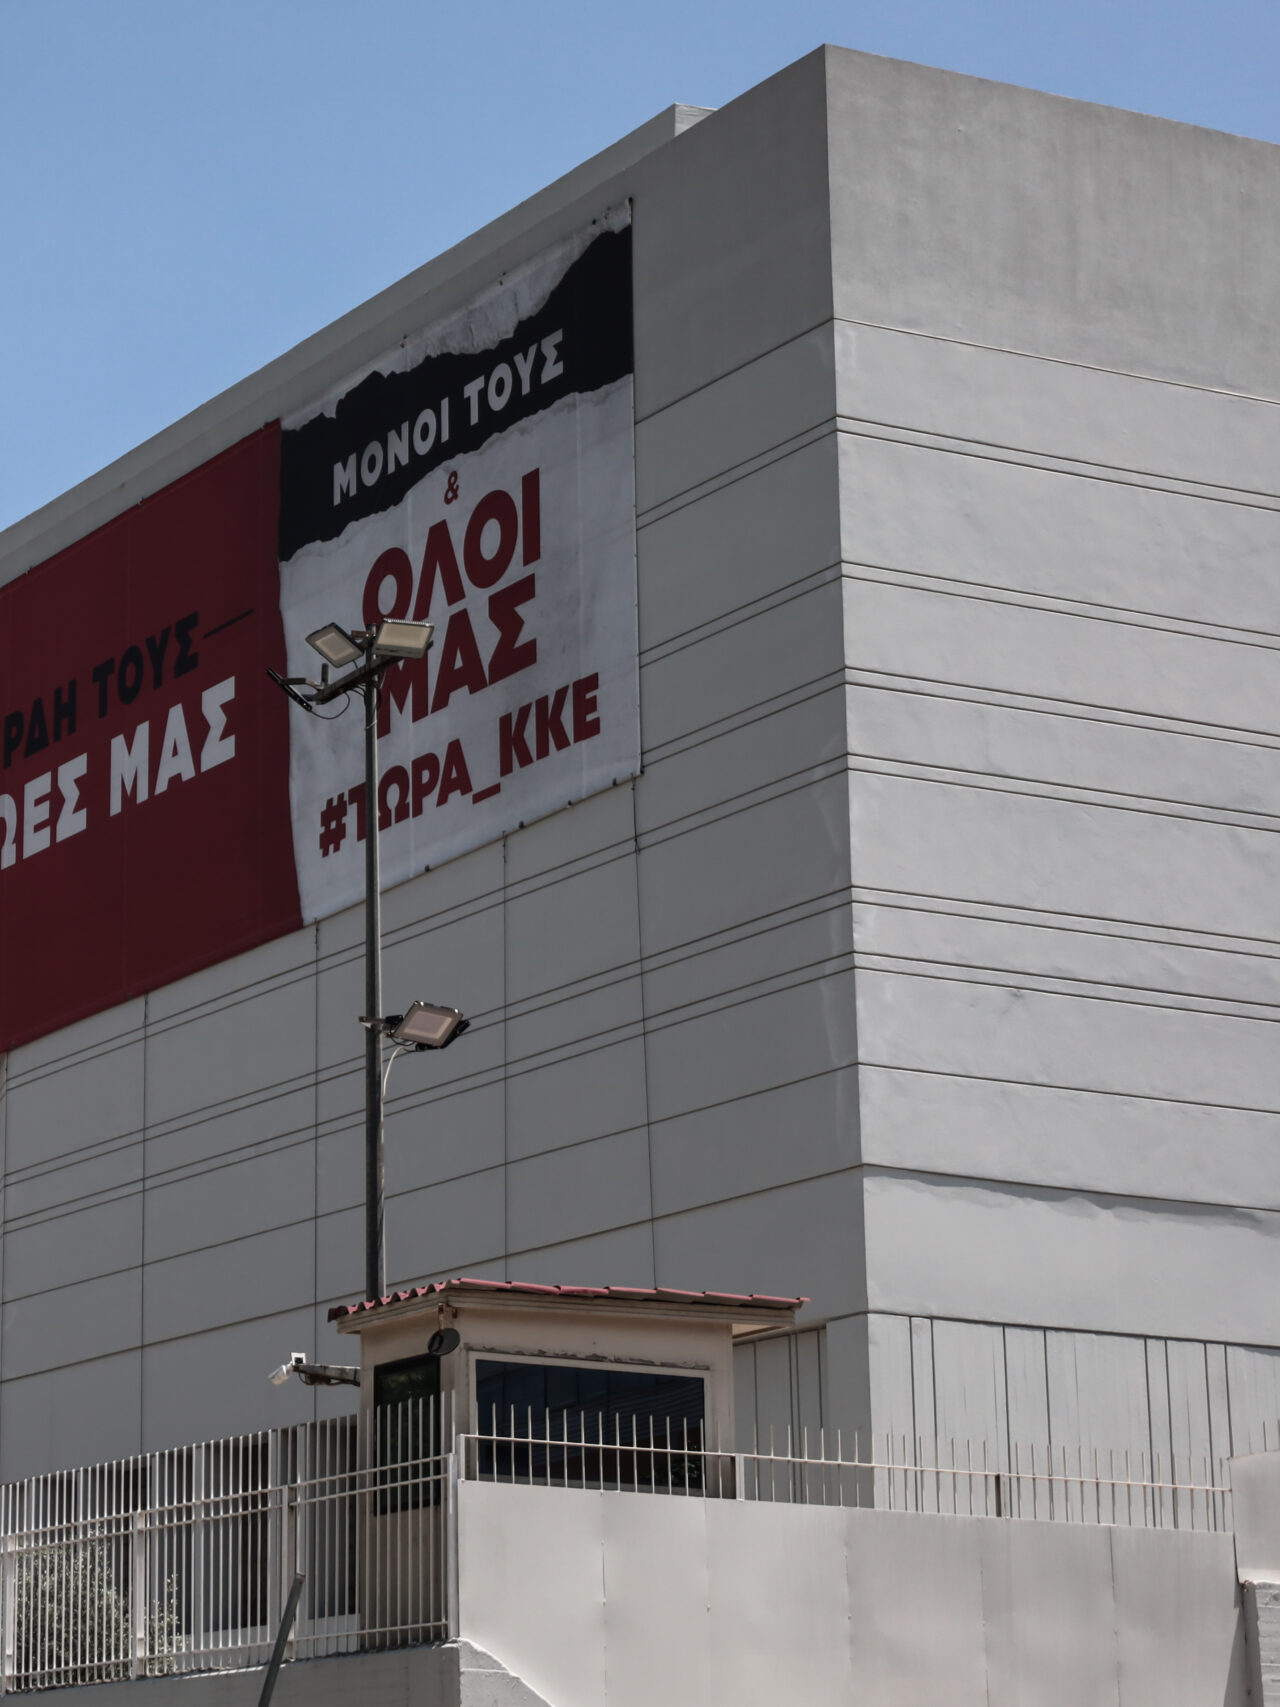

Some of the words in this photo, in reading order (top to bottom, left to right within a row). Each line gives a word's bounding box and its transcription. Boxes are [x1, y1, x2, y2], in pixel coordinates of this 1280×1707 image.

[333, 397, 449, 506] ΜΟΝΟΙ
[463, 328, 563, 426] ΤΟΥΣ
[444, 470, 459, 505] &
[362, 467, 541, 625] ΟΛΟΙ
[92, 611, 199, 719] ΤΟΥΣ
[376, 573, 537, 740] ΜΑΣ
[110, 676, 236, 817] ΜΑΣ
